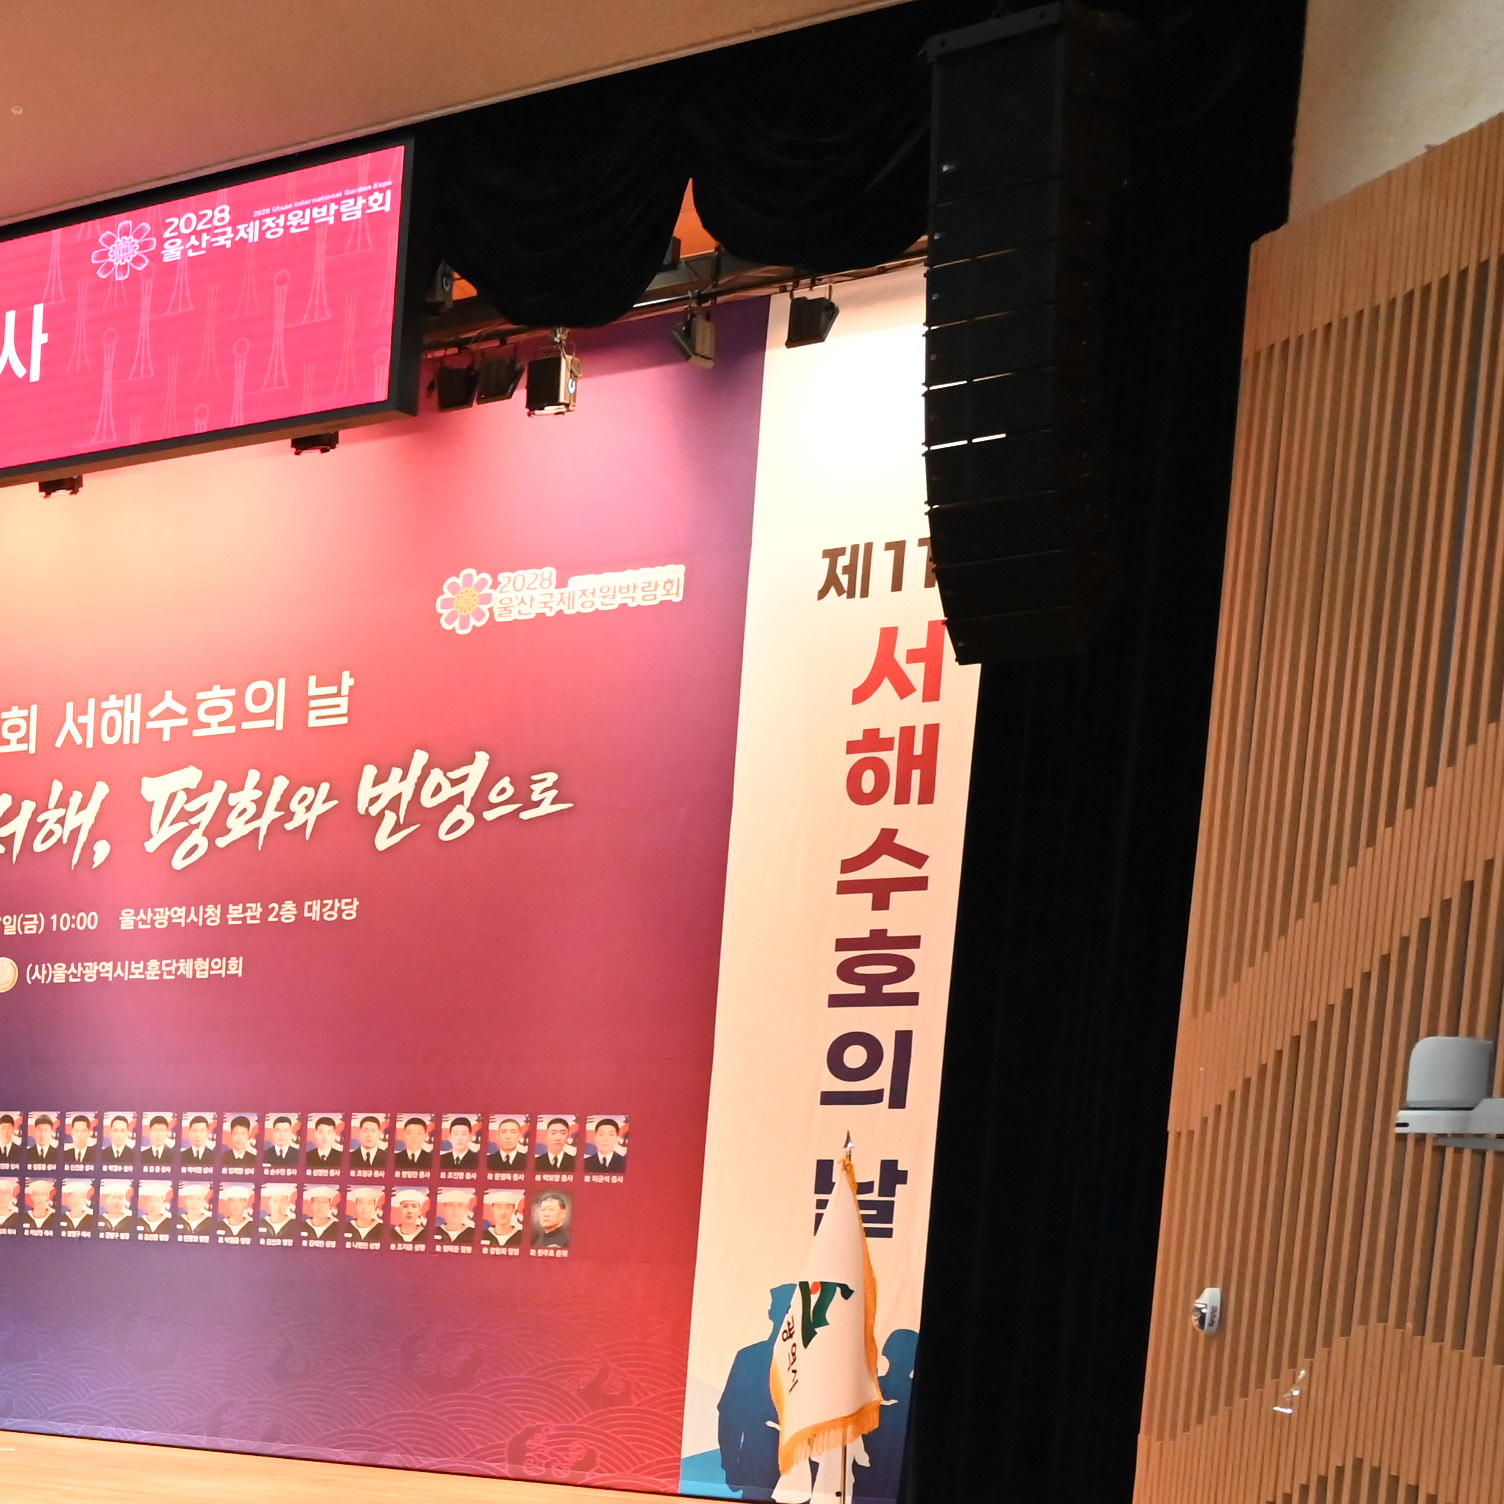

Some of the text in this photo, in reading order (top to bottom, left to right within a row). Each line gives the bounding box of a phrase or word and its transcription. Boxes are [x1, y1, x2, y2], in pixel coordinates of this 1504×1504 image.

[161, 189, 392, 263] 울산국제정원박람회
[163, 204, 231, 239] 2028
[498, 570, 553, 594] 2028
[817, 537, 937, 601] 제11
[495, 577, 683, 619] 울산국제정원박람회
[54, 675, 287, 749] 서해수호의
[306, 670, 355, 728] 날
[140, 764, 339, 871] 평화와
[355, 749, 574, 852] 번영으로
[820, 619, 948, 1109] 서해수호의
[49, 911, 98, 934] 10:00
[118, 902, 222, 931] 울산광역시청
[226, 901, 263, 928] 본관
[267, 899, 298, 924] 2층
[302, 897, 359, 922] 대강당
[25, 956, 244, 985] (사)울산광역시보훈단체협의회
